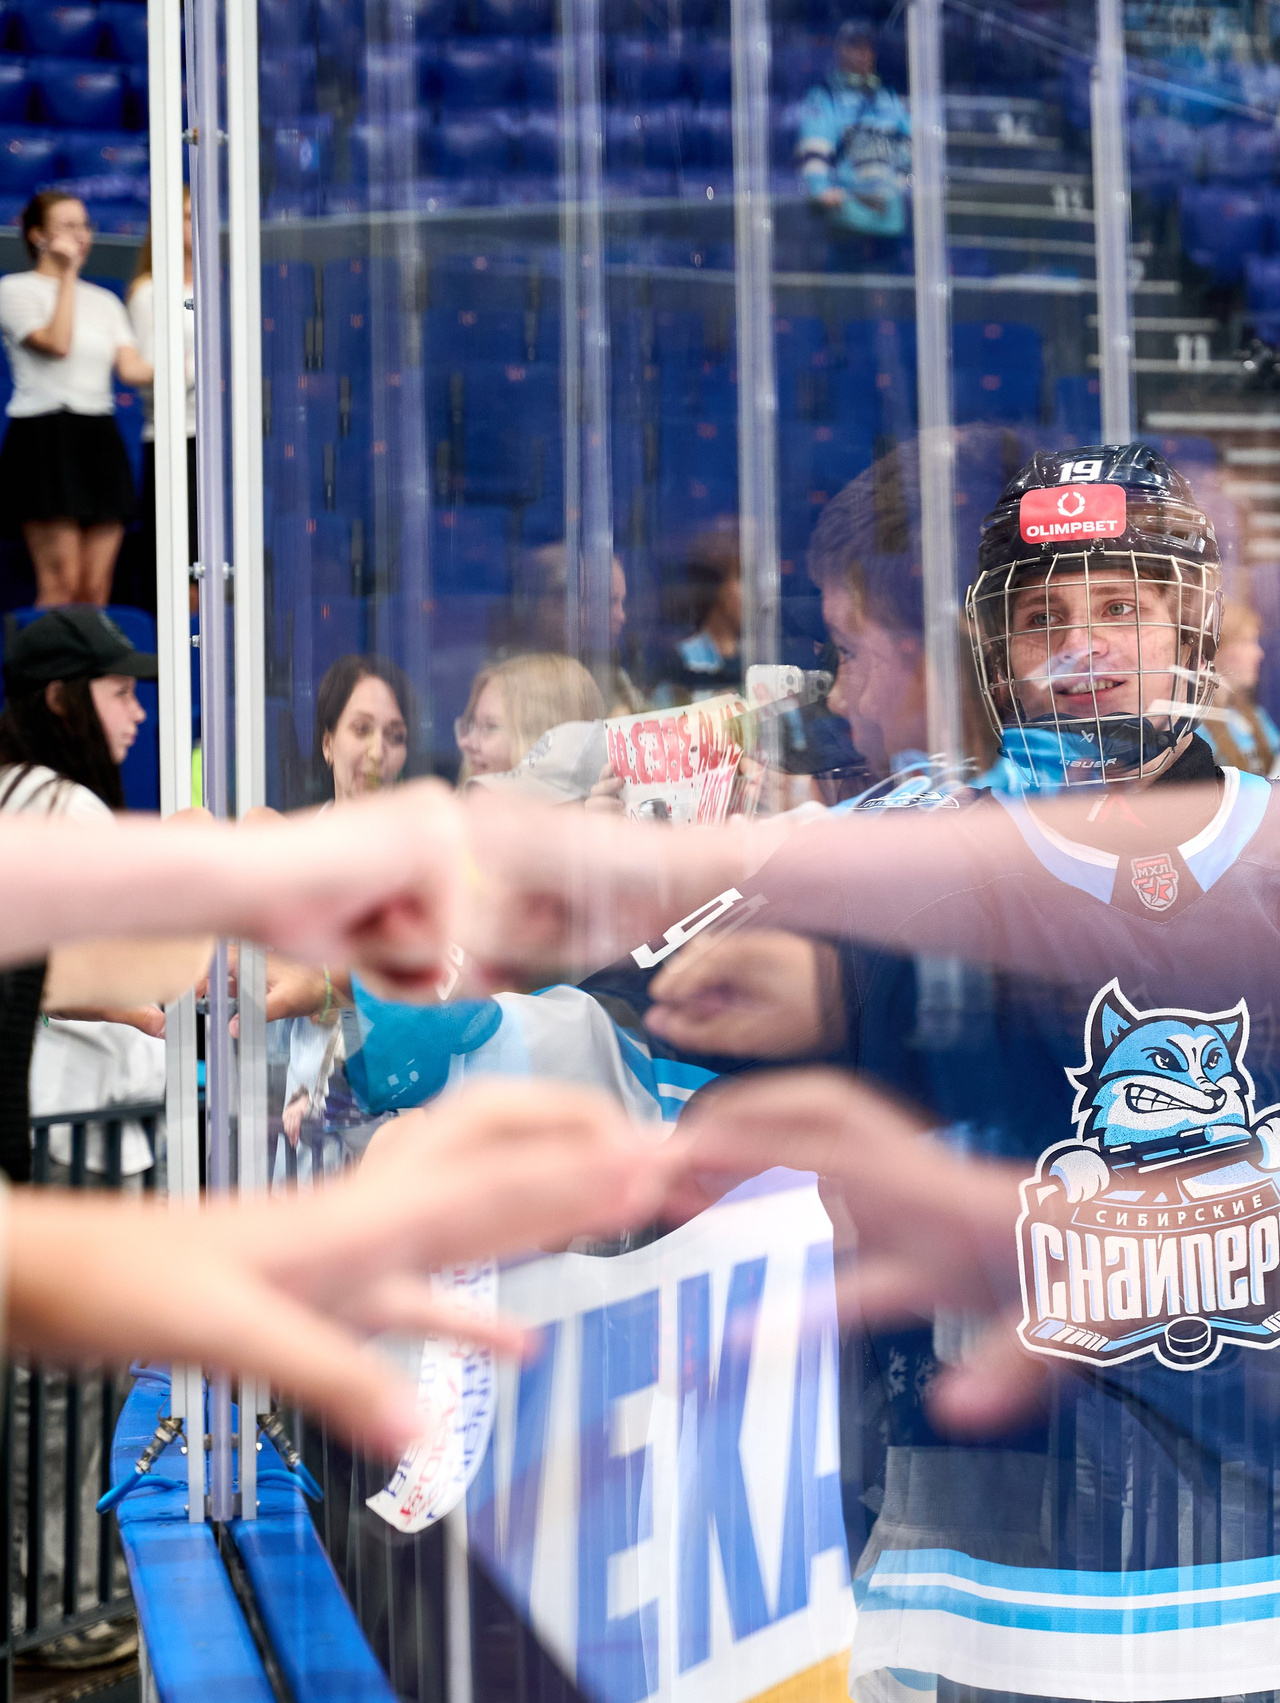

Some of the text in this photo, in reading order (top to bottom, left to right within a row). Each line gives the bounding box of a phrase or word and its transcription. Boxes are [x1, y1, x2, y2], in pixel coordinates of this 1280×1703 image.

[1058, 460, 1103, 482] 19
[1026, 520, 1118, 537] OLIMPBET
[1137, 863, 1169, 878] МХЛ
[1096, 1194, 1264, 1227] СИБИРСКИЕ
